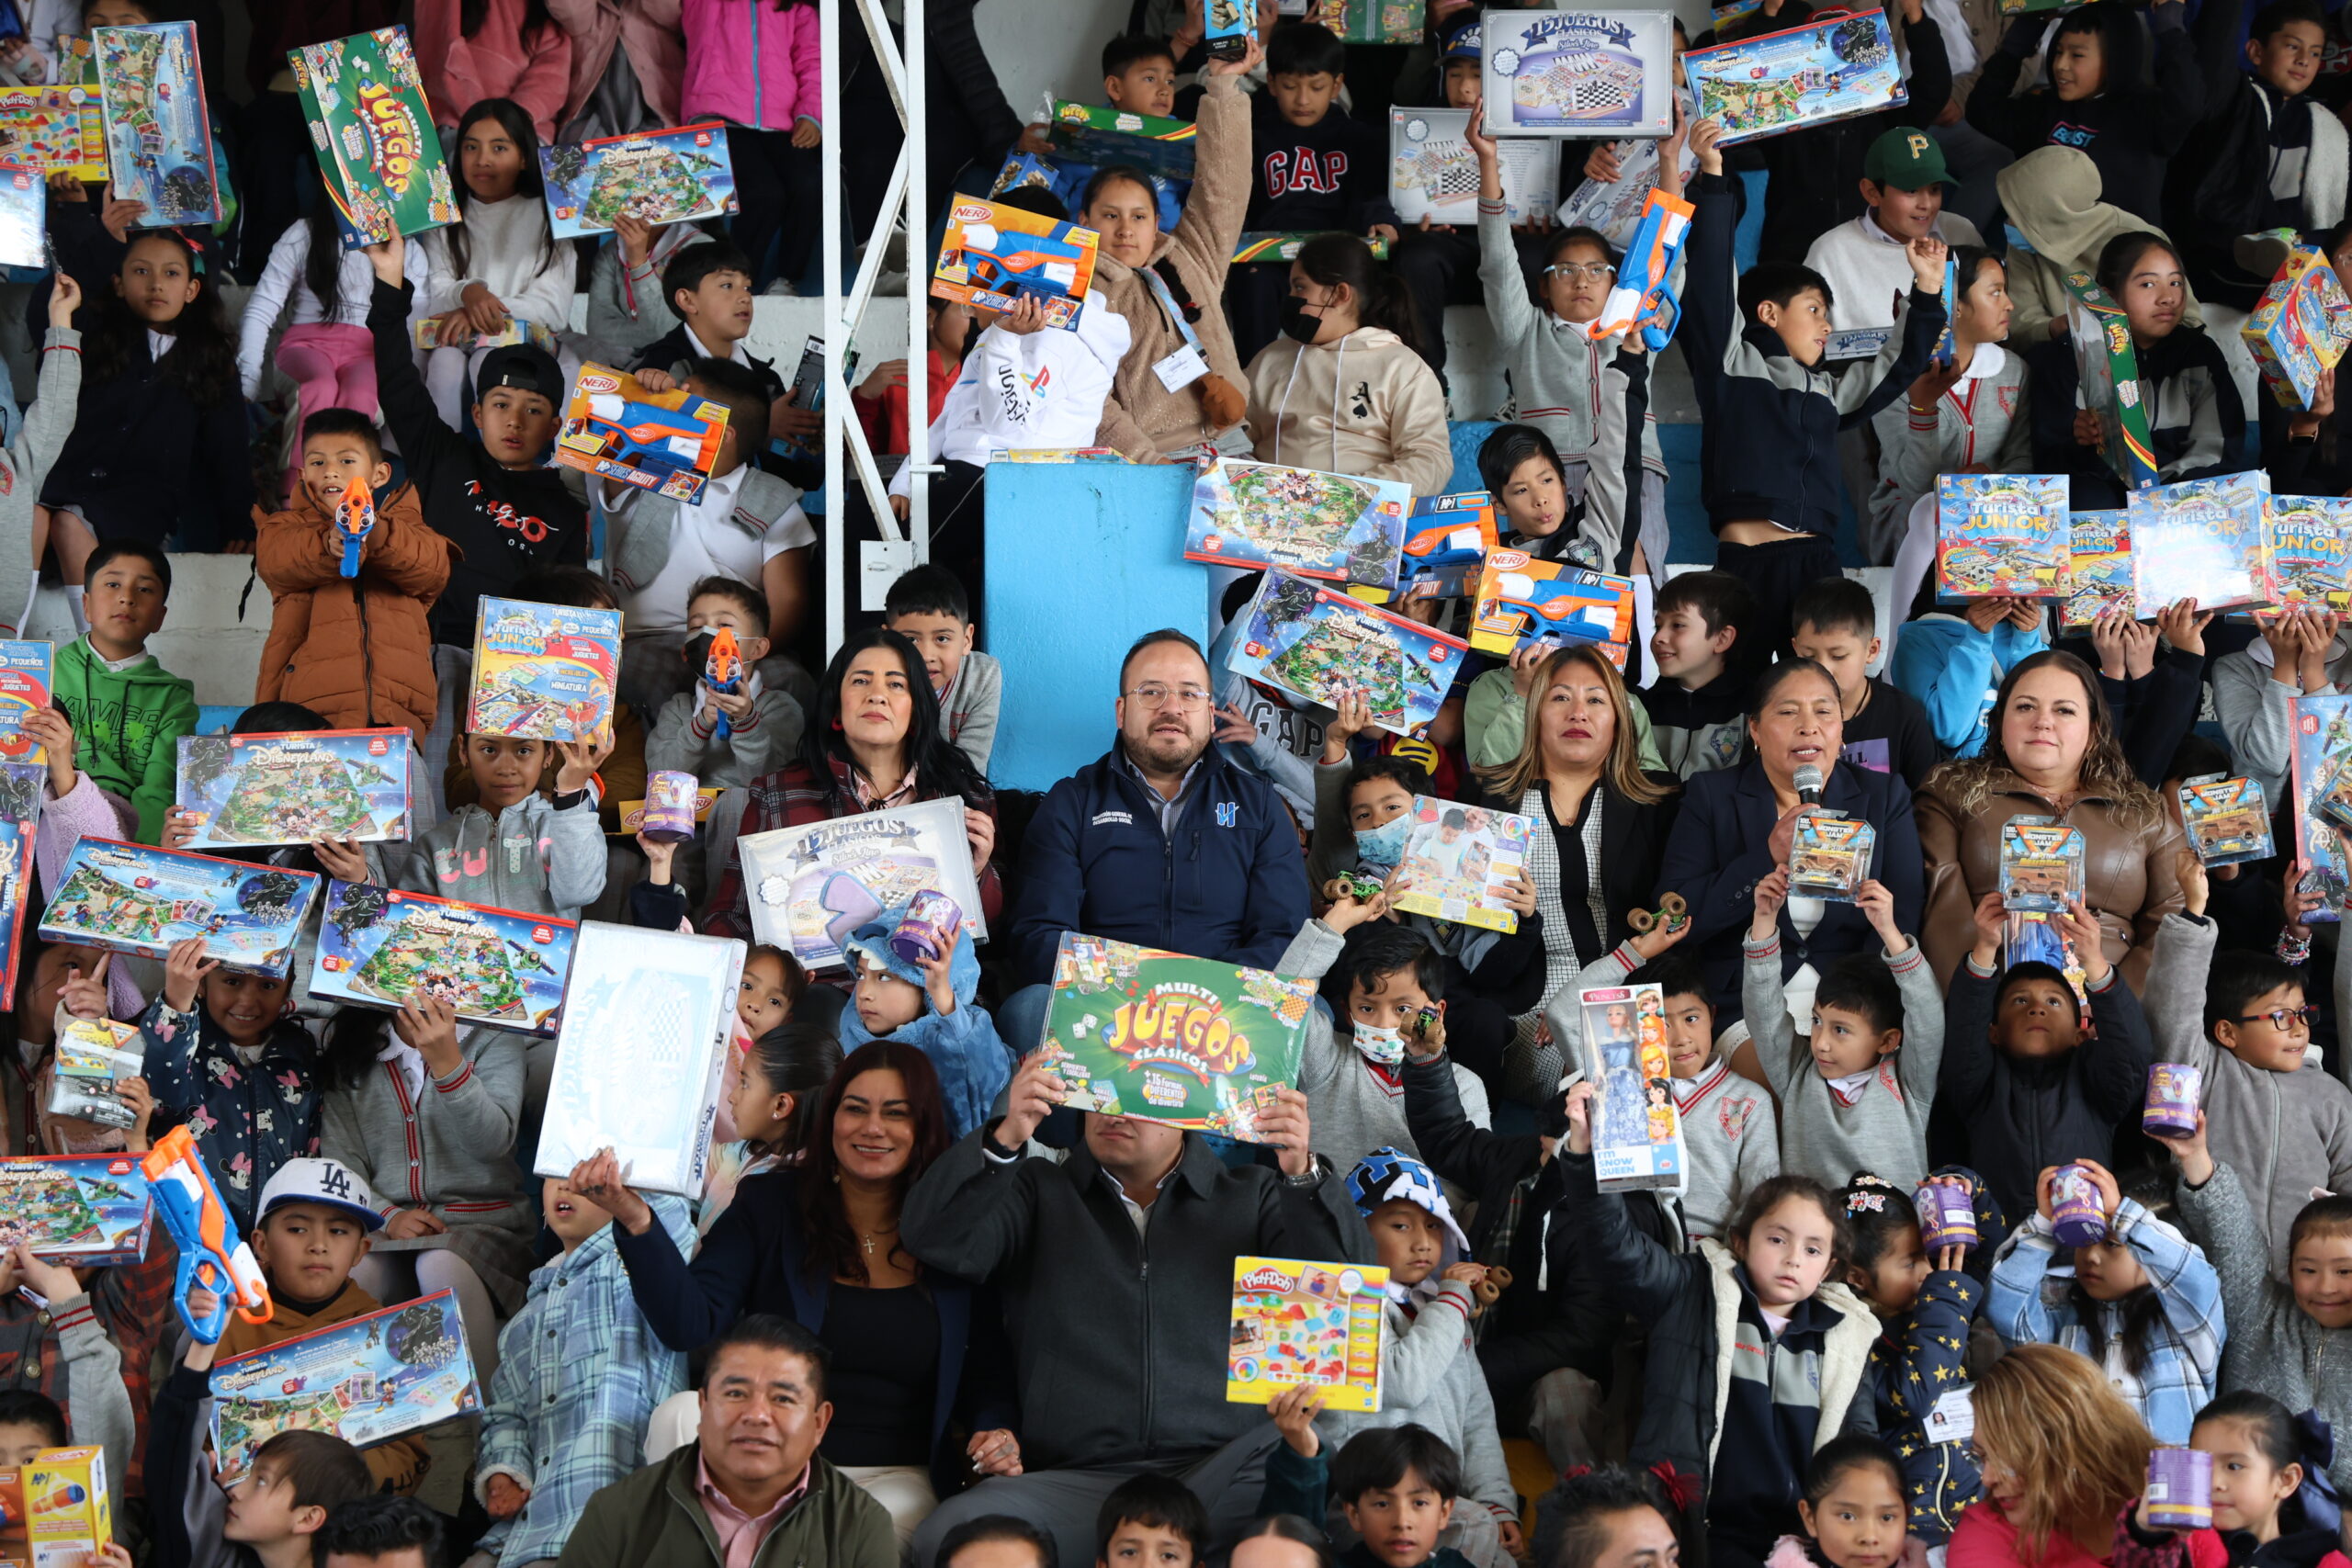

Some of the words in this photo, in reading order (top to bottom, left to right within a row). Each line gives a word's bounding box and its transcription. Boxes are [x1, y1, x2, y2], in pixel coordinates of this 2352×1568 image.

[1536, 16, 1553, 36] 15
[1551, 13, 1621, 34] JUEGOS
[359, 82, 414, 194] JUEGOS
[402, 105, 423, 155] MULTI
[1907, 135, 1928, 159] P
[1264, 145, 1348, 199] GAP
[954, 206, 992, 220] NERF
[580, 377, 618, 389] NERF
[608, 464, 632, 479] SERIES
[627, 469, 659, 490] AGILITY
[1488, 554, 1529, 568] NERF
[1249, 700, 1324, 757] GAP
[280, 742, 316, 750] TURISTA
[2212, 792, 2232, 801] JAM
[803, 829, 824, 854] 15
[820, 817, 903, 844] JUEGOS
[3, 874, 14, 911] TURISTA
[438, 909, 478, 922] TURISTA
[1155, 981, 1219, 1006] MULTI
[1109, 1001, 1250, 1075] JUEGOS
[1133, 1045, 1208, 1074] CLÁSICOS
[320, 1162, 350, 1200] LA
[1600, 1166, 1635, 1177] QUEEN
[241, 1361, 268, 1374] TURISTA
